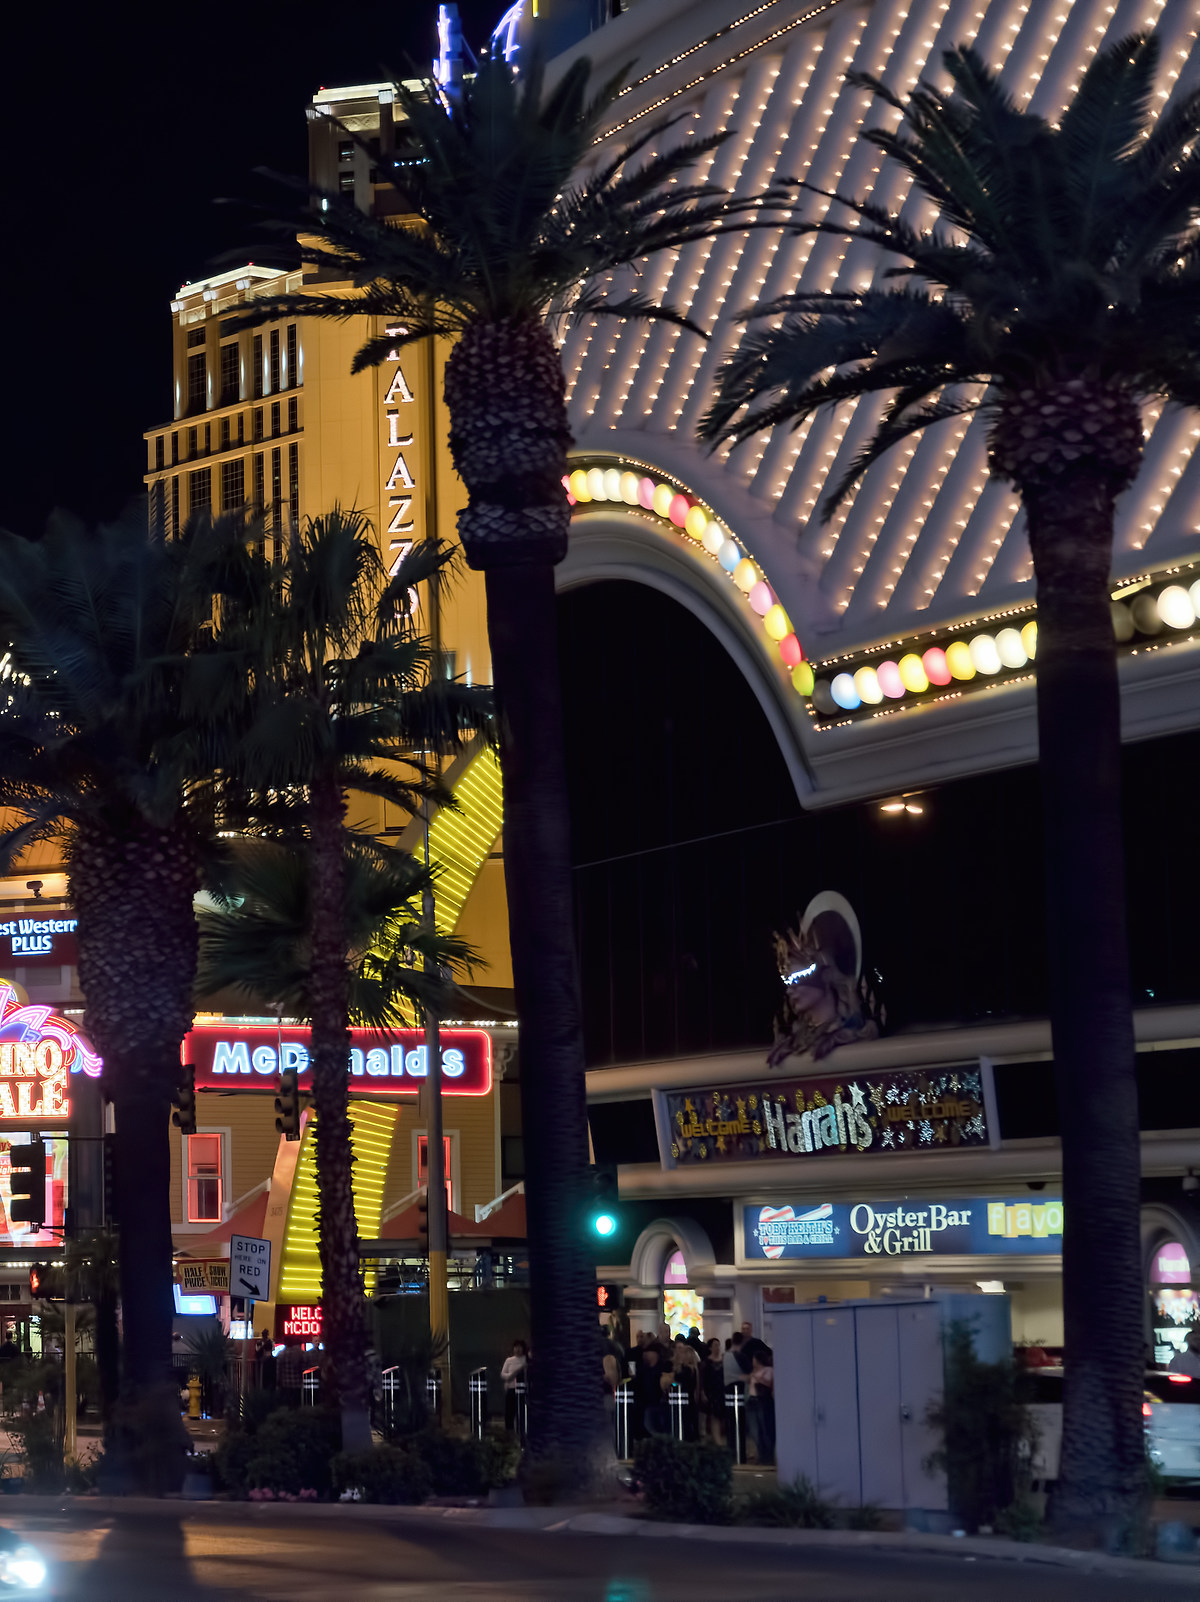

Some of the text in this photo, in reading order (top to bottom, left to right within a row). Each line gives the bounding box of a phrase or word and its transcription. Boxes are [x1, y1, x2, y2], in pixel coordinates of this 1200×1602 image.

[11, 935, 53, 952] PLUS
[211, 1041, 465, 1078] McDnald's
[680, 1092, 972, 1153] WELCOME Harrah's WELCOME
[850, 1203, 972, 1236] Oyster Bar
[990, 1207, 1064, 1232] flavo
[758, 1220, 833, 1235] TOBY KEITH'S
[236, 1242, 266, 1254] STOP
[184, 1265, 226, 1278] HALF SHOW
[239, 1264, 261, 1277] RED
[184, 1277, 206, 1288] PRICE
[291, 1306, 323, 1321] WELC
